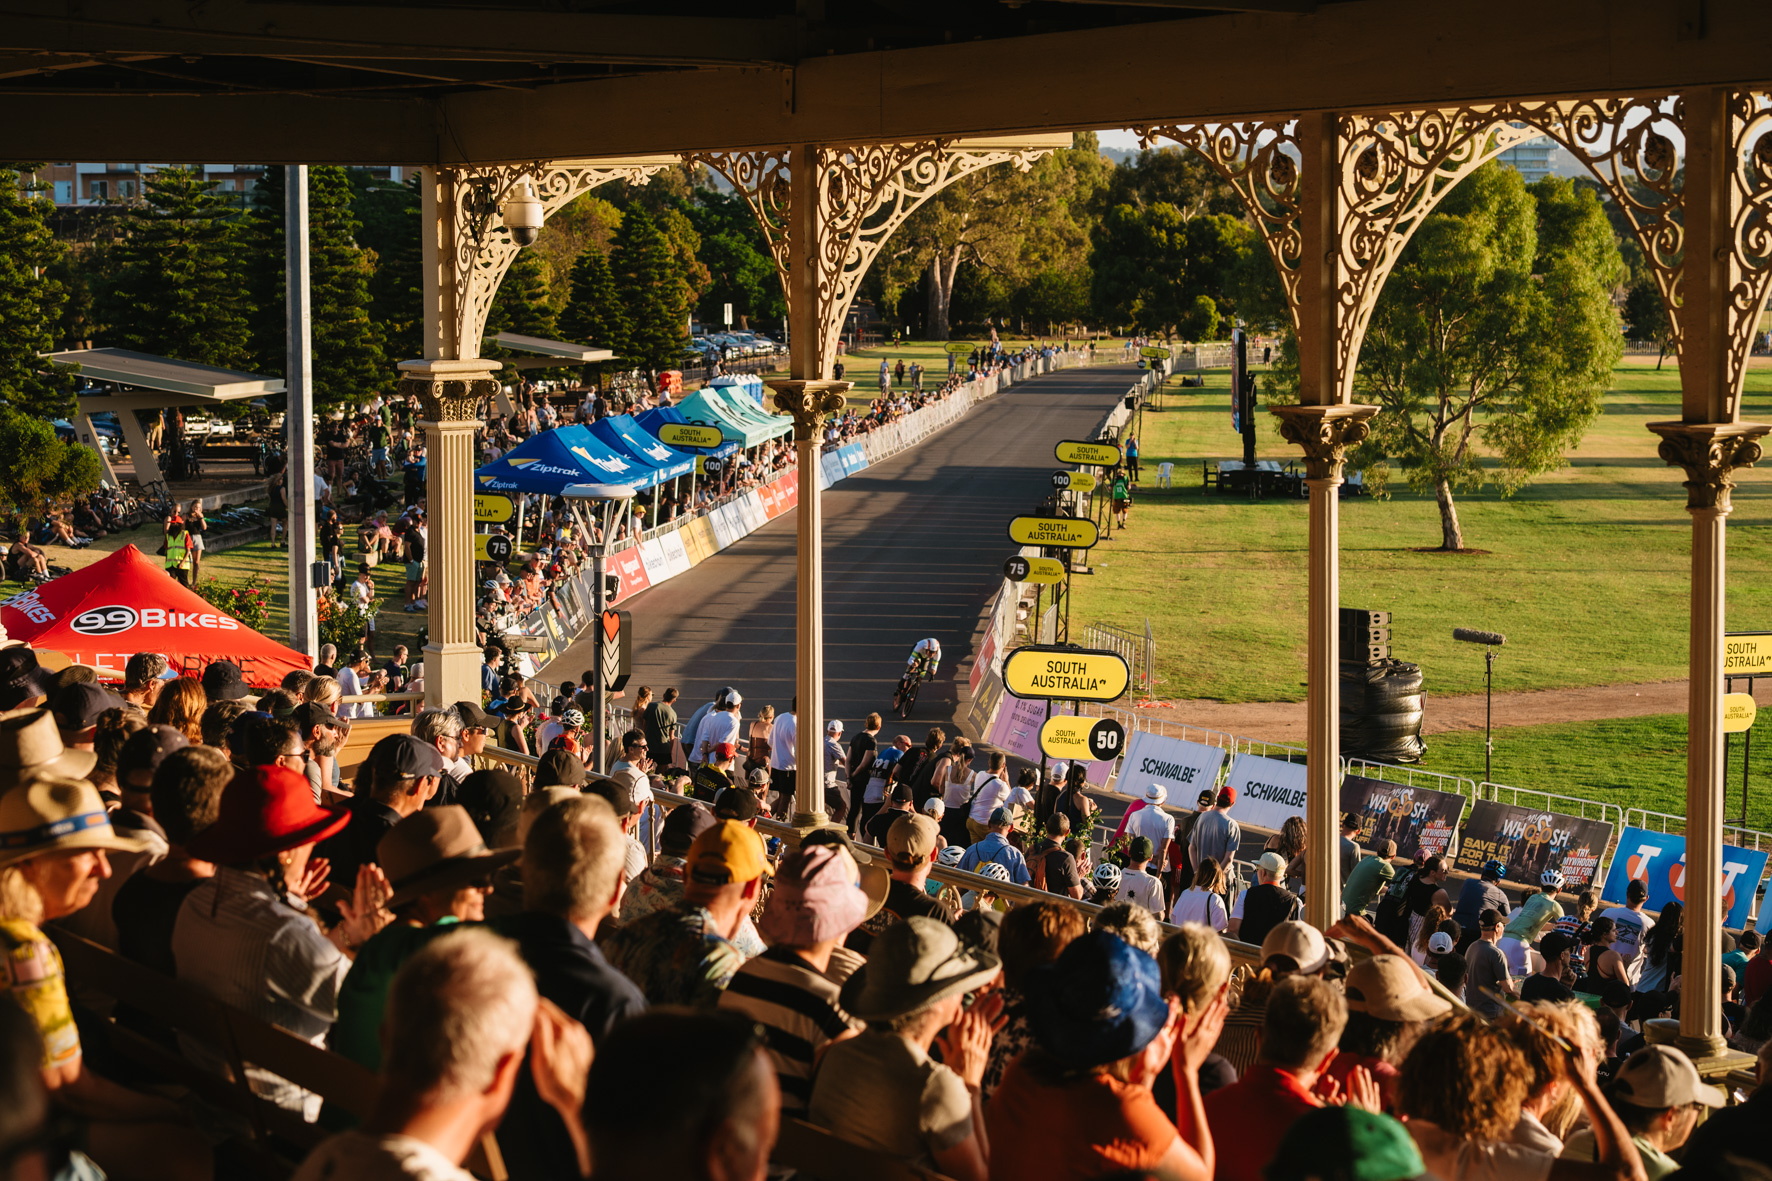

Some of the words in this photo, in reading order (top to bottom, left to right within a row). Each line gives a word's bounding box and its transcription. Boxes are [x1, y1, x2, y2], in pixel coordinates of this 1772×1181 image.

[672, 435, 707, 443] AUSTRALIA
[1077, 446, 1099, 454] SOUTH
[1069, 453, 1105, 461] AUSTRALIA
[530, 463, 581, 477] Ziptrak
[704, 461, 721, 471] 100
[491, 481, 518, 490] Ziptrak
[1053, 475, 1069, 485] 100
[1038, 522, 1068, 532] SOUTH
[1027, 531, 1077, 542] AUSTRALIA
[492, 542, 507, 555] 75
[1009, 562, 1025, 575] 75
[1727, 642, 1757, 654] SOUTH
[1046, 660, 1087, 675] SOUTH
[1030, 674, 1098, 690] AUSTRALIA
[1027, 703, 1044, 717] SUGAR
[1019, 715, 1039, 728] DELICIOUS
[1055, 729, 1076, 737] SOUTH
[1047, 736, 1081, 745] AUSTRALIA
[1096, 730, 1118, 750] 50
[1139, 757, 1196, 784] SCHWALBE
[1243, 780, 1307, 808] SCHWALBE
[1369, 793, 1430, 820] WHOOSH
[1364, 817, 1377, 828] IT
[1433, 820, 1446, 829] TRY
[1502, 819, 1571, 848] WHOOSH
[1463, 836, 1497, 853] SAVE
[1498, 844, 1511, 855] IT
[1460, 847, 1484, 860] FOR
[1577, 848, 1590, 858] TRY
[1457, 856, 1480, 867] GOOD
[1561, 856, 1599, 868] MYWHOOSH
[1561, 865, 1581, 876] TODAY
[1581, 867, 1594, 876] FOR
[1565, 875, 1583, 885] FREE!
